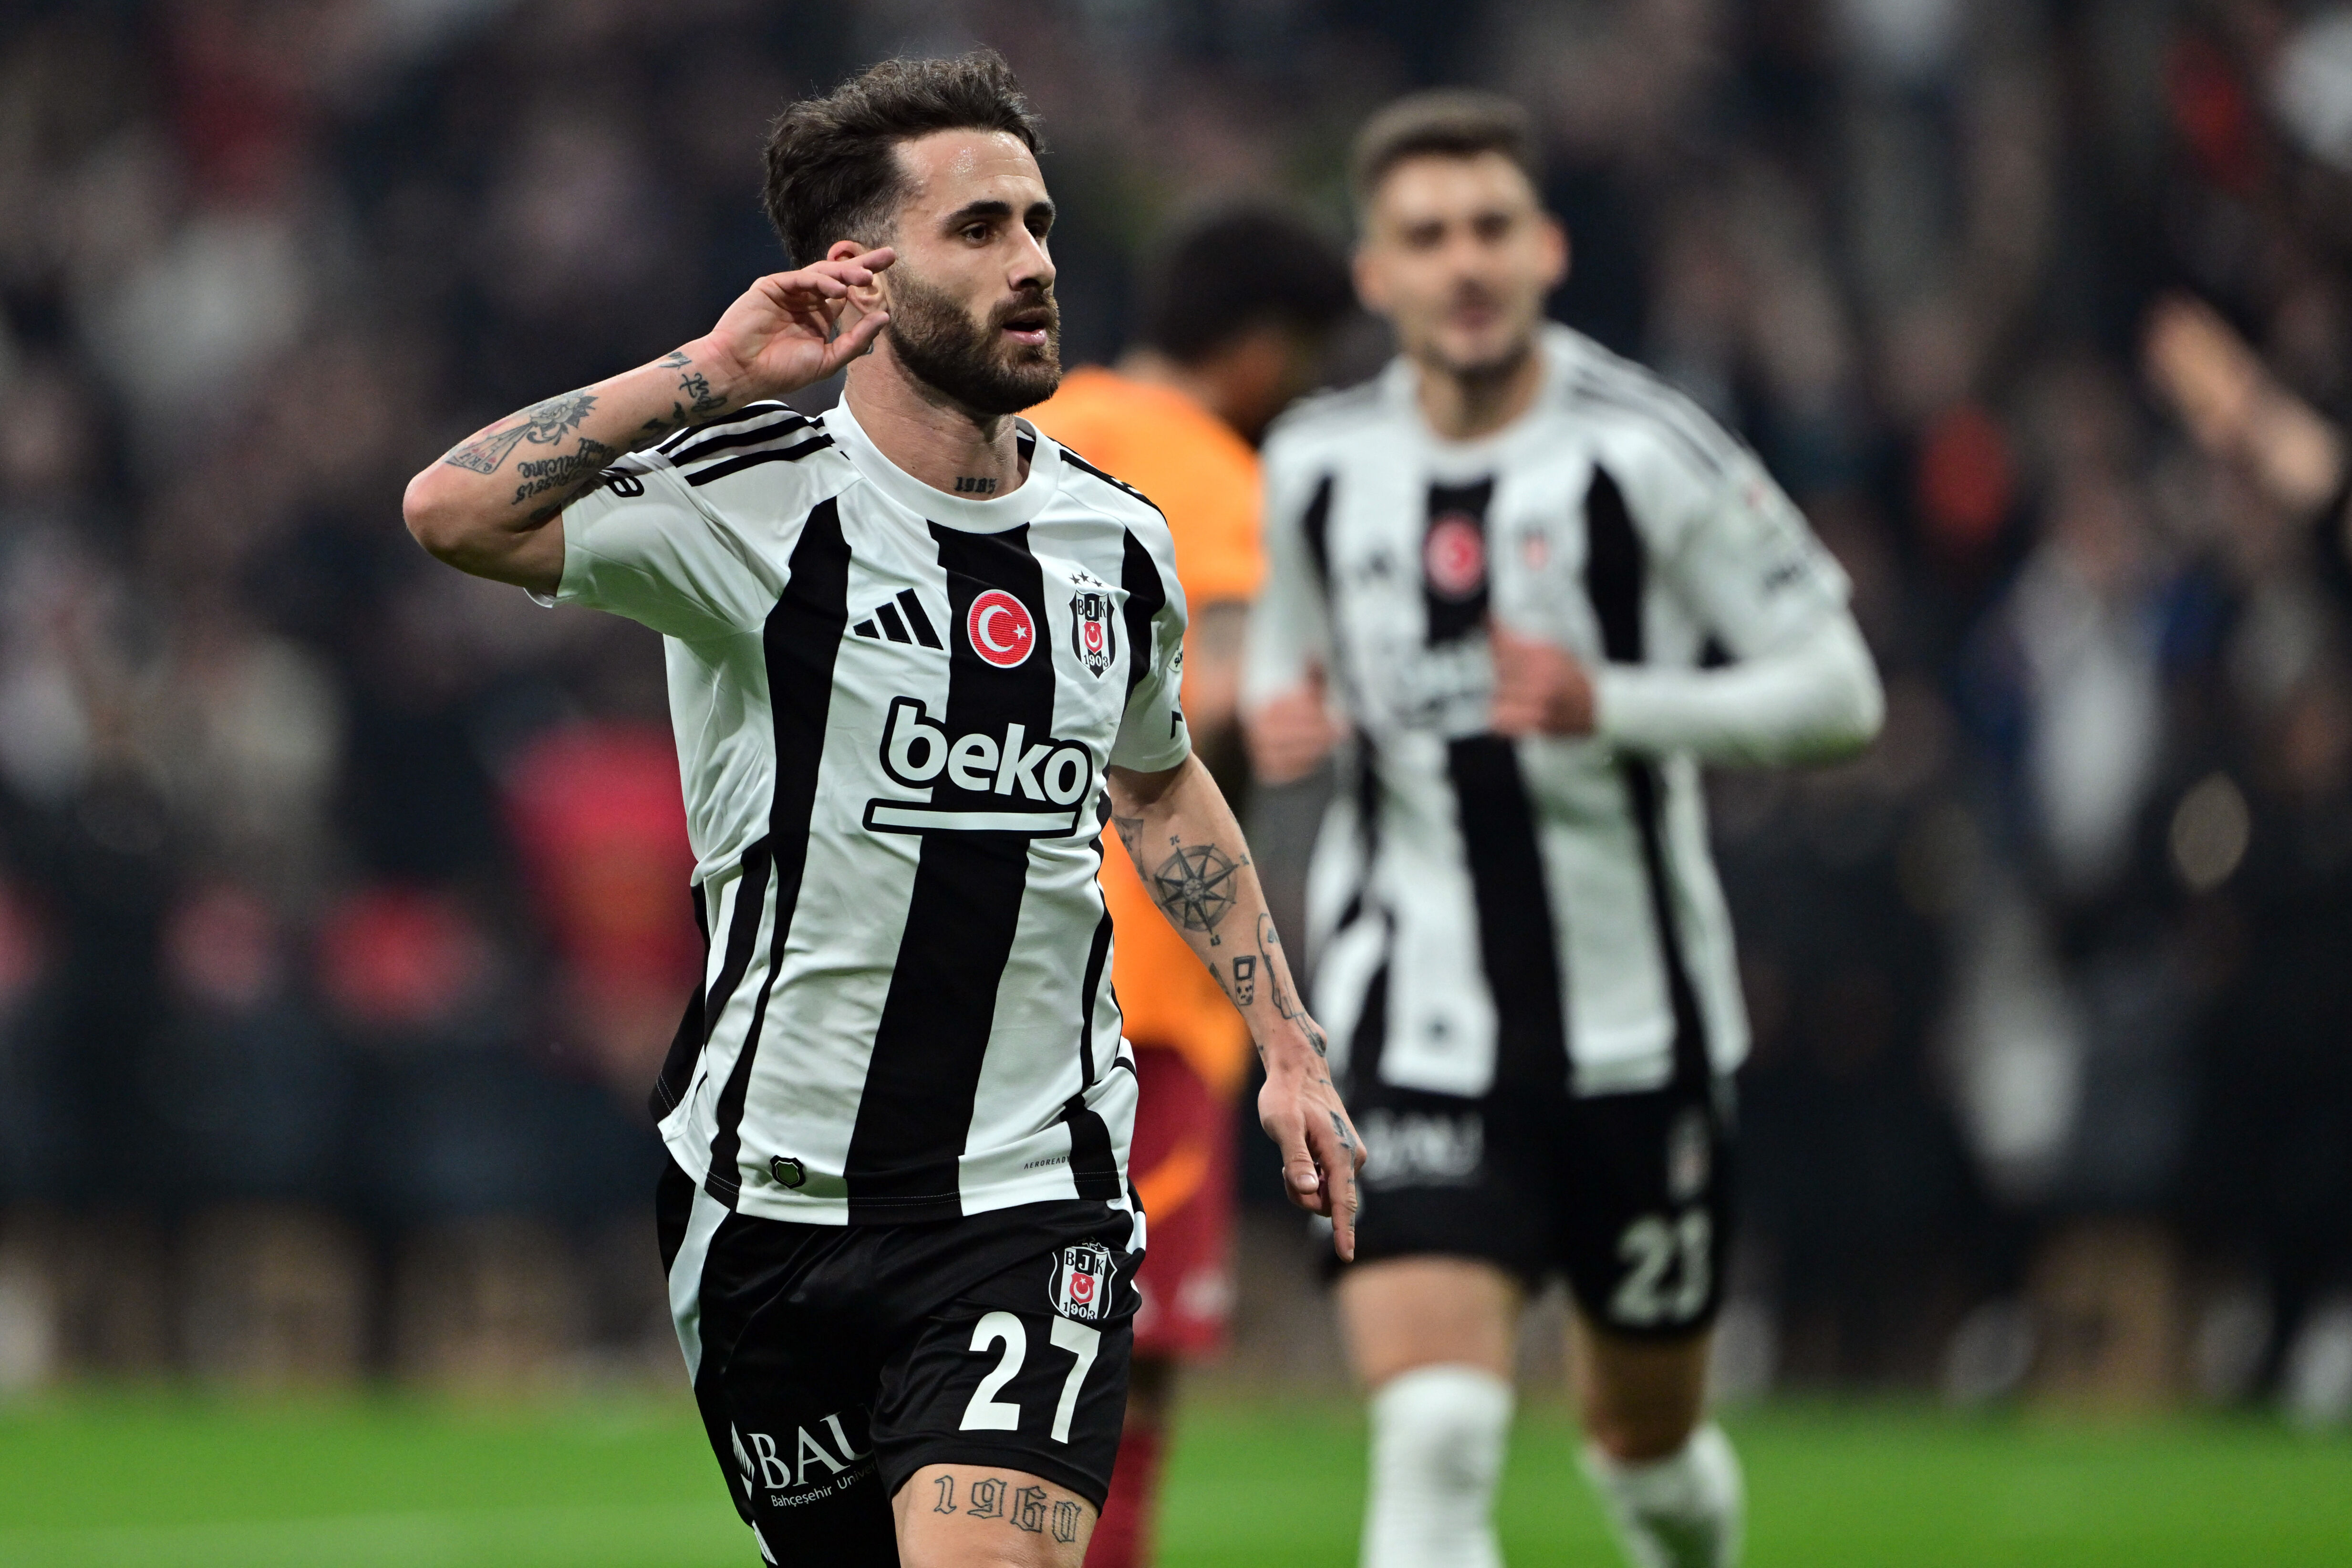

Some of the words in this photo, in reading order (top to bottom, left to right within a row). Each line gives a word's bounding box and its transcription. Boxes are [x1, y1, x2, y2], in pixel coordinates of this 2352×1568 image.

[1077, 598, 1107, 618] BJK
[1084, 654, 1109, 668] 1903
[885, 701, 1090, 806] beko
[1065, 1251, 1104, 1276] BJK
[959, 1311, 1101, 1445] 27
[771, 1485, 832, 1507] Bahçeşehir
[837, 1460, 877, 1490] Univer
[933, 1474, 1083, 1543] 1960
